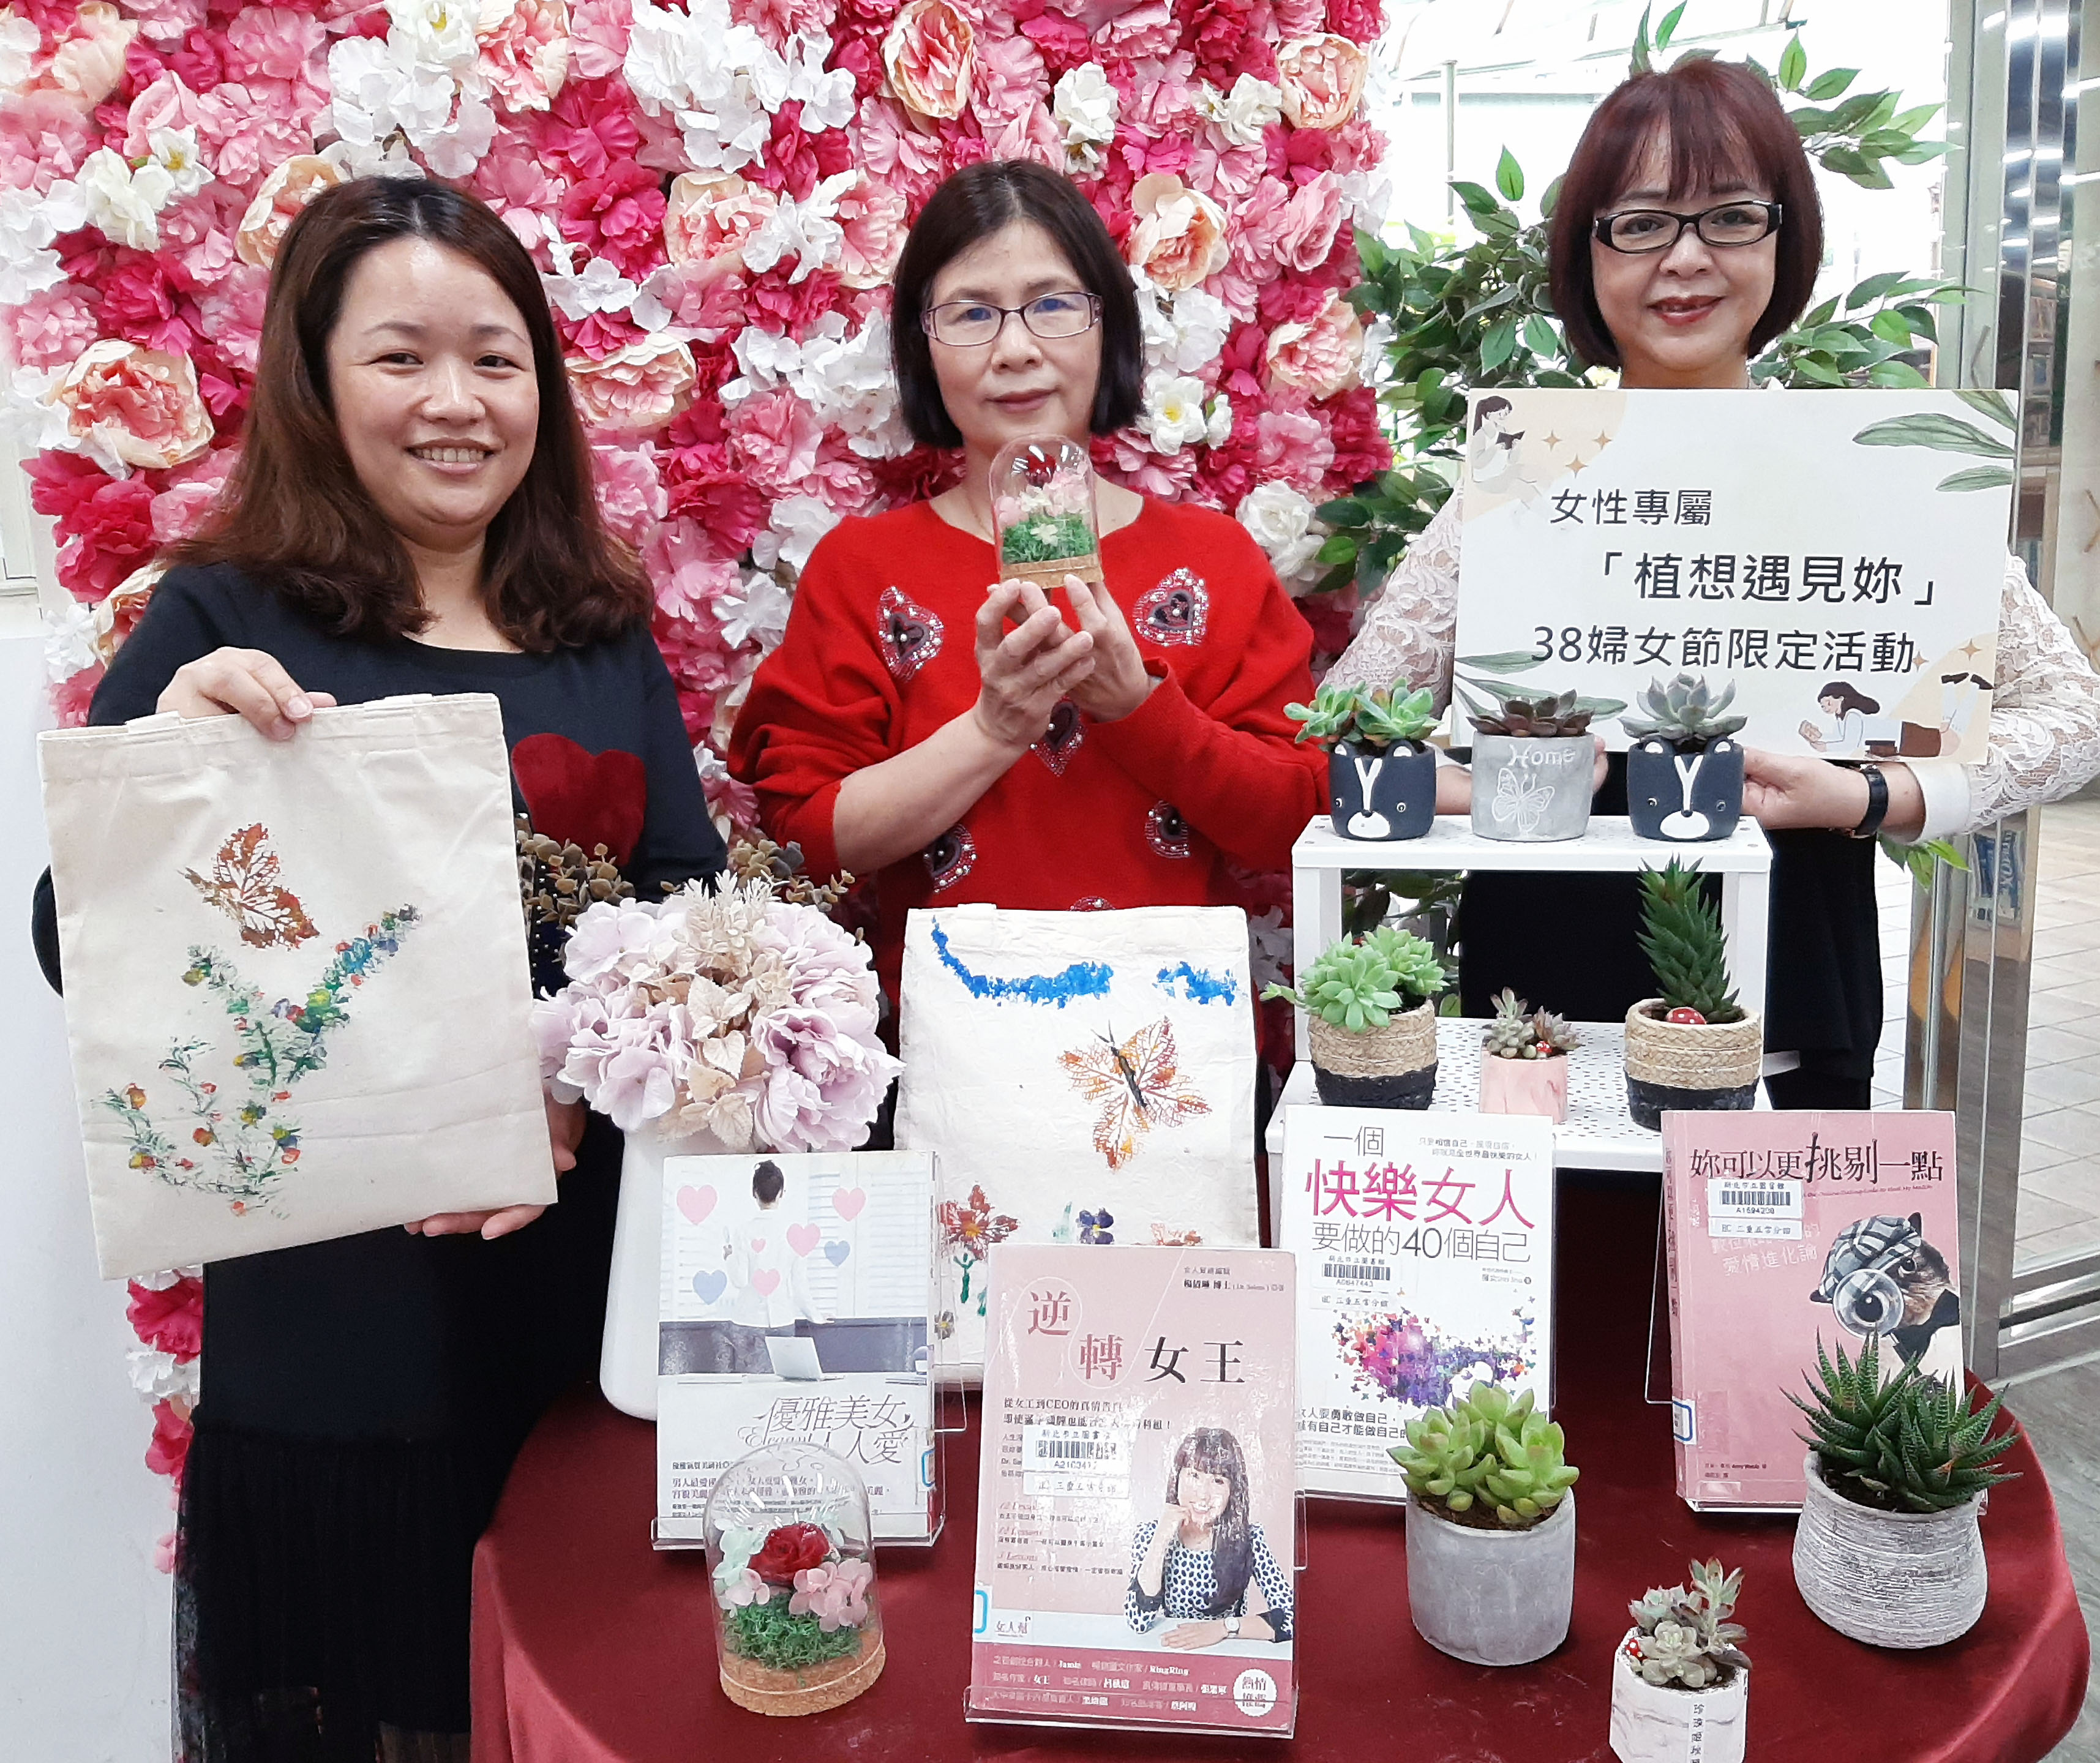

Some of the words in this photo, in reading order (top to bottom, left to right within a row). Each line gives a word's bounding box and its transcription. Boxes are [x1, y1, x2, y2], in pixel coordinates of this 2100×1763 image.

[1550, 488, 1712, 526] 女性專屬
[1602, 550, 1935, 605] 「植想遇見妳」
[1533, 624, 1914, 673] 38婦女節限定活動
[1507, 744, 1576, 769] Home
[1324, 1126, 1384, 1158] 一個
[1690, 1131, 1943, 1184] 妳可以更挑剔一點
[1305, 1158, 1536, 1229] 快樂女人
[1311, 1222, 1531, 1263] 要做的40個自己
[753, 1394, 907, 1445] 優雅美女
